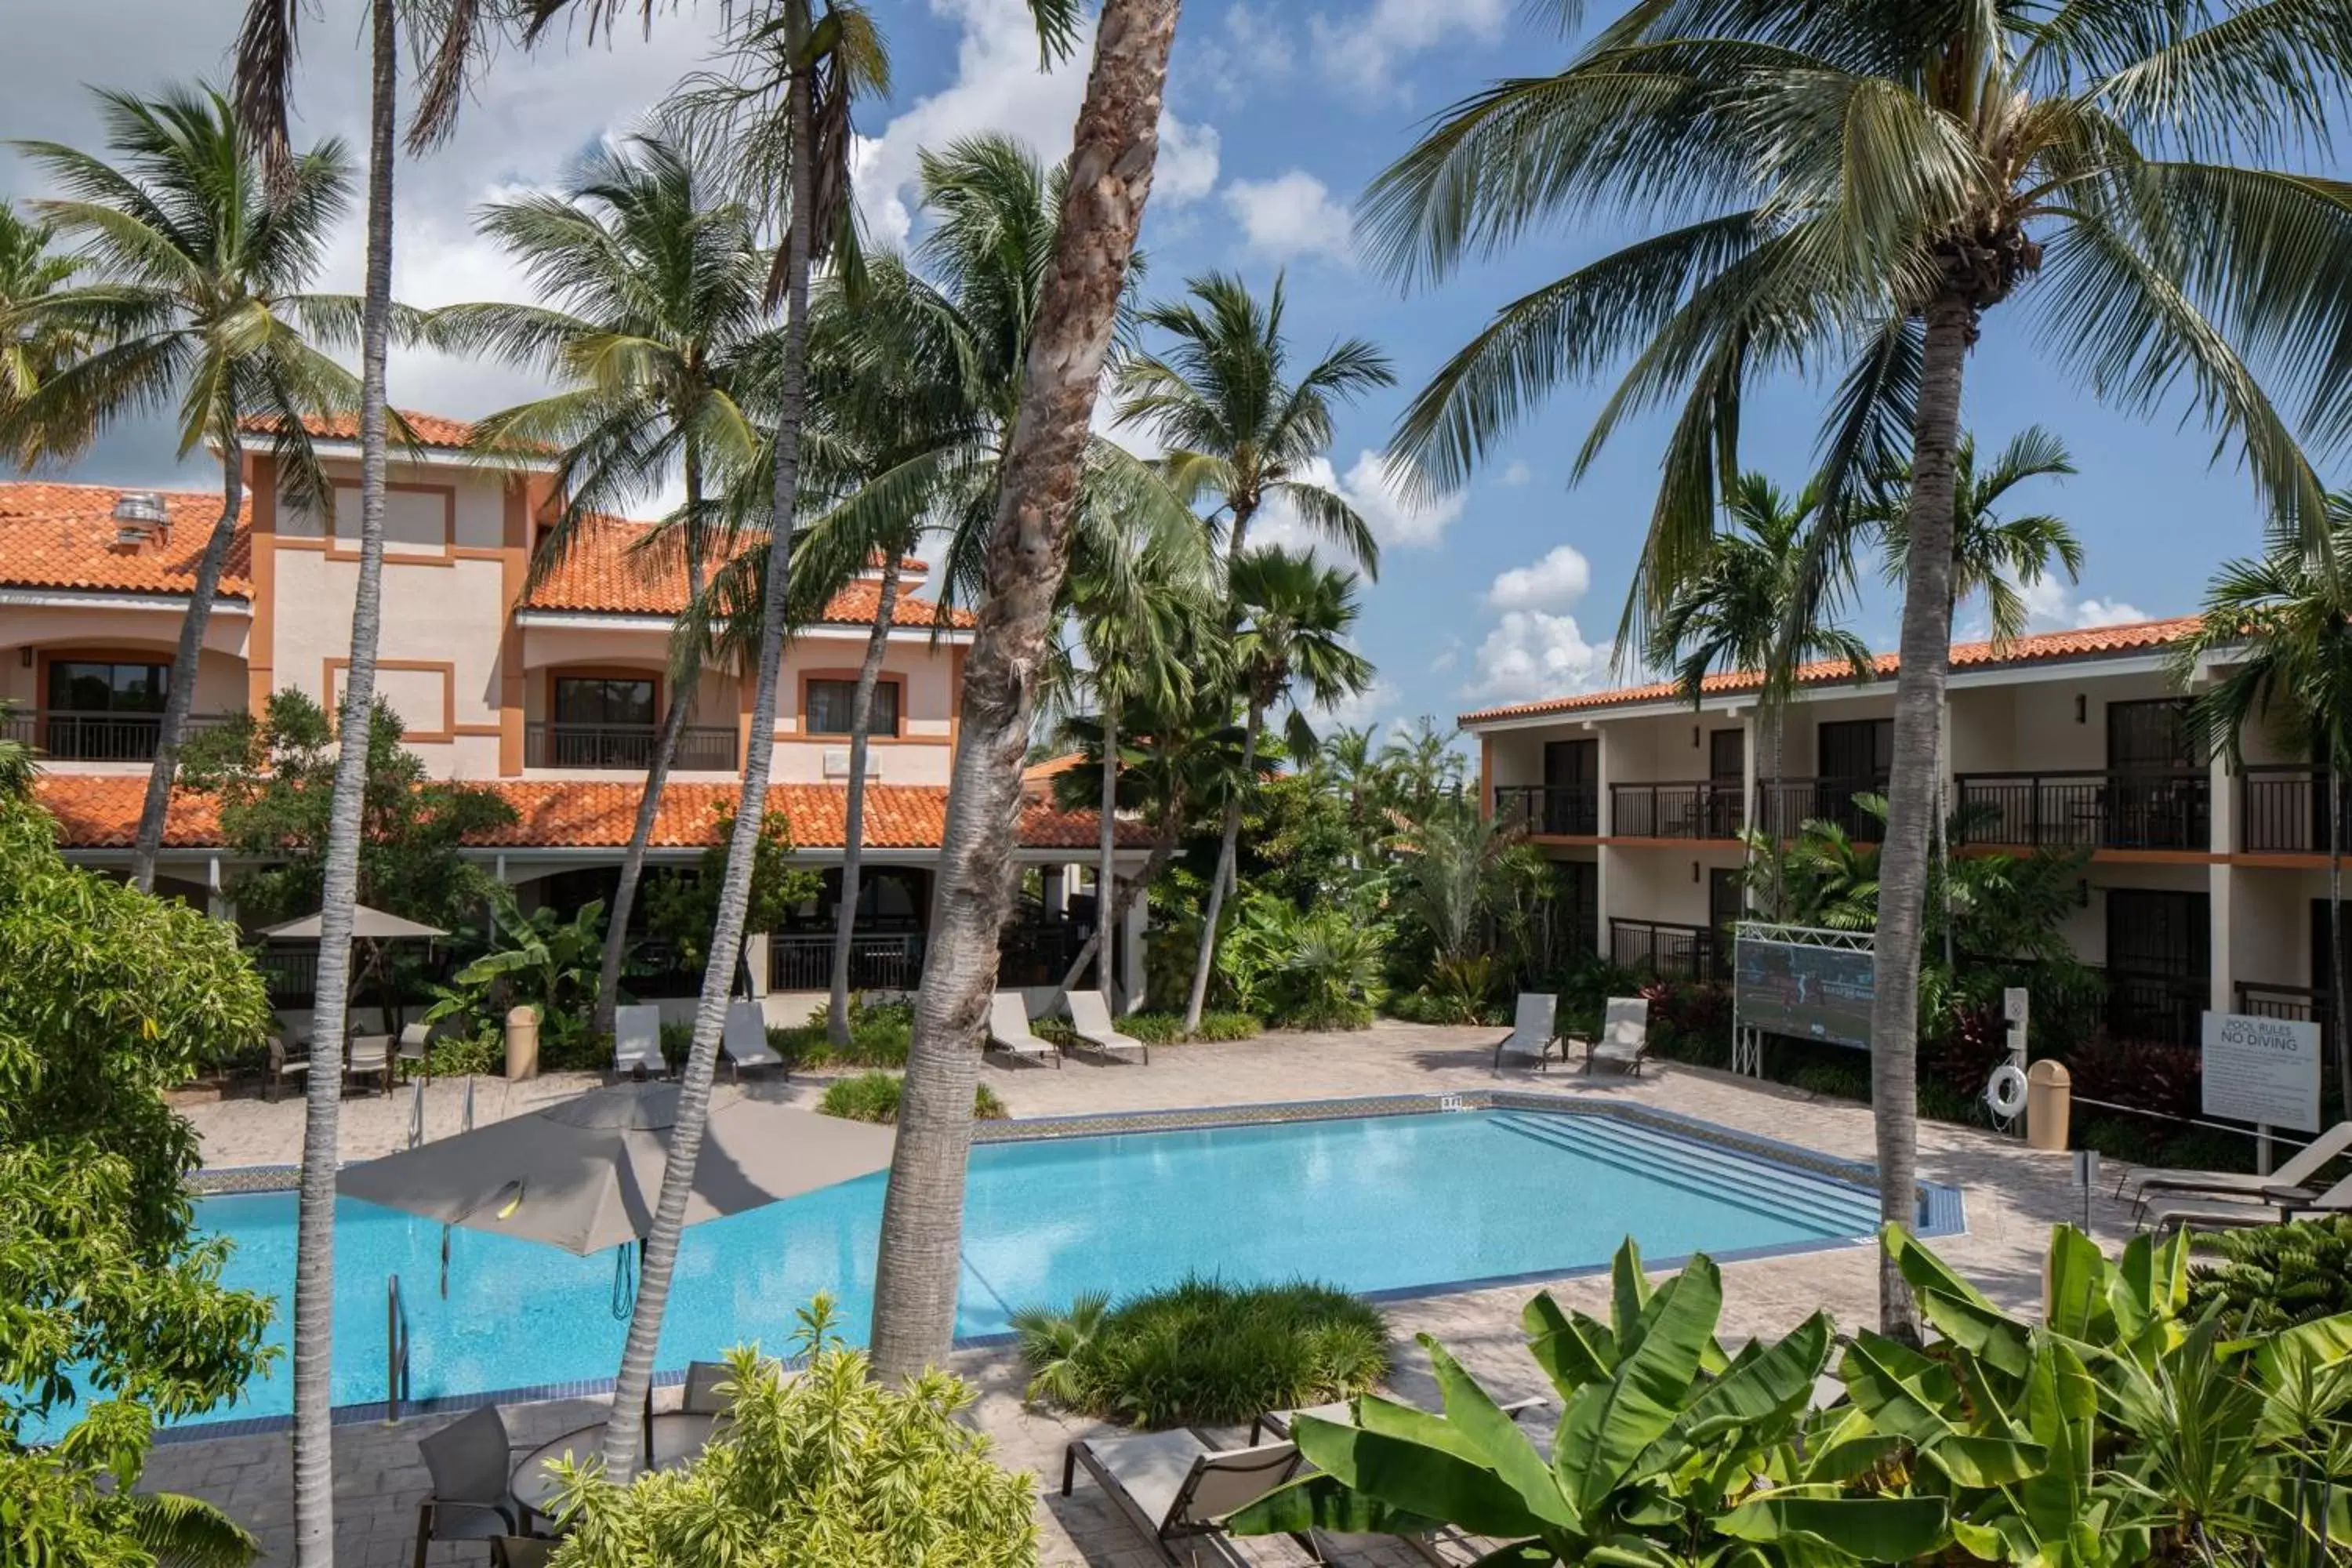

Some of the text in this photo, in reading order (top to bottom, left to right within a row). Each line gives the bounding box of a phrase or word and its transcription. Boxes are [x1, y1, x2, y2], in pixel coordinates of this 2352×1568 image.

[2226, 1018, 2292, 1036] POOL RULES
[2221, 1031, 2298, 1051] NO DIVING
